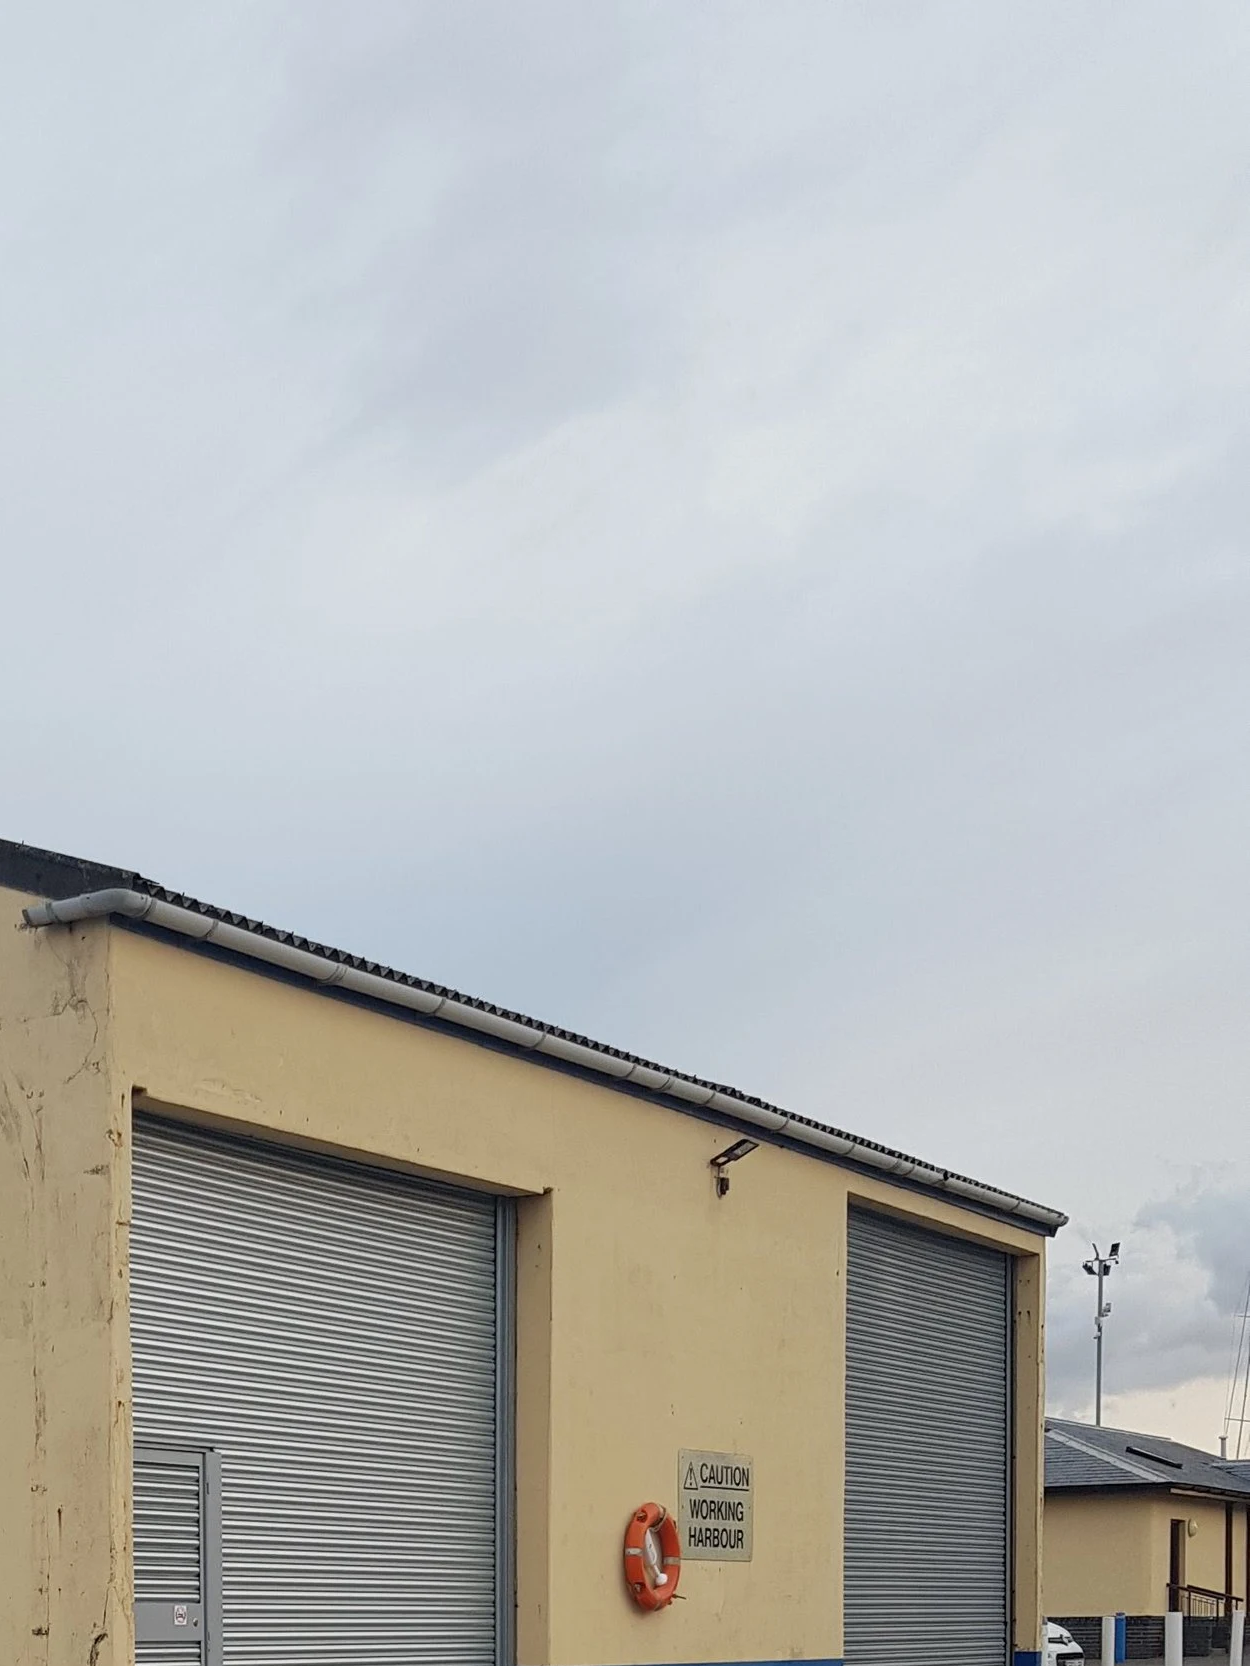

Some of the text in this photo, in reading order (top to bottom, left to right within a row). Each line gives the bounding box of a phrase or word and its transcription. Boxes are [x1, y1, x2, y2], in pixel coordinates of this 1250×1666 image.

[700, 1463, 749, 1487] CAUTION
[690, 1499, 744, 1521] WORKING
[689, 1527, 744, 1549] HARBOUR
